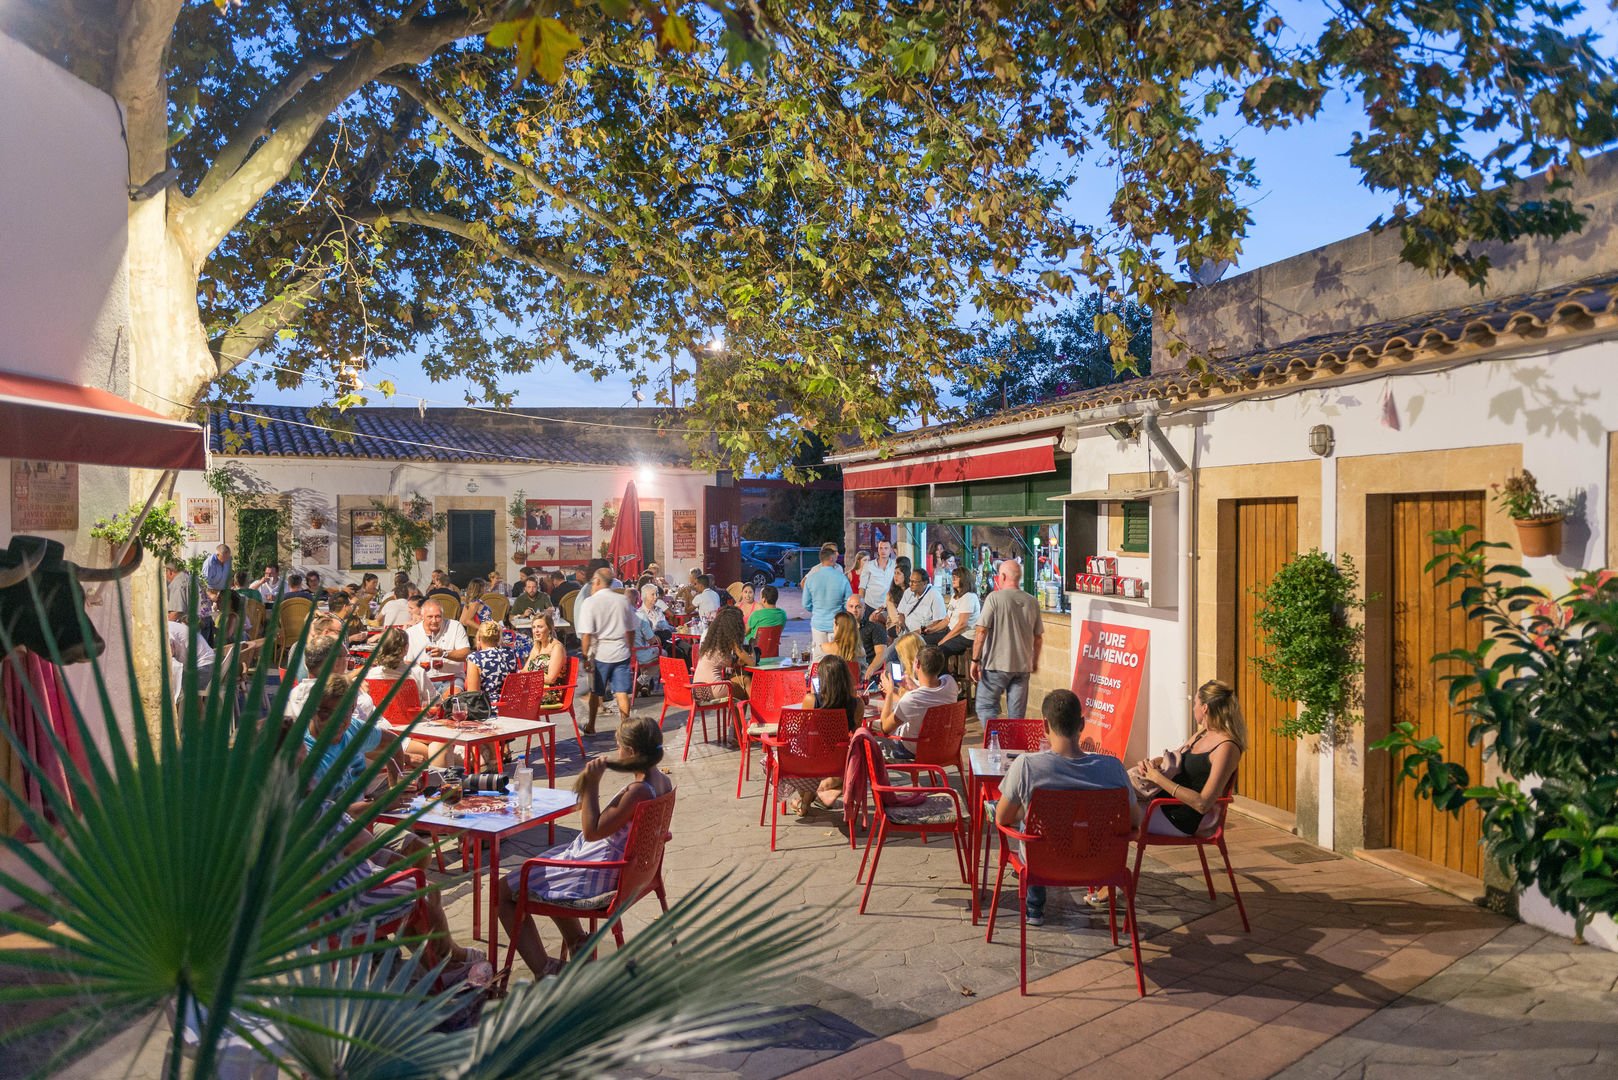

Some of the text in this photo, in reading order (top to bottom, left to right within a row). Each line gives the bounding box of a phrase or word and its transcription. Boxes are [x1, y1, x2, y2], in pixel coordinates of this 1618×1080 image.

[1098, 630, 1127, 649] PURE
[1082, 644, 1139, 668] FLAMENCO
[1089, 673, 1122, 689] TUESDAYS
[1085, 697, 1115, 714] SUNDAYS
